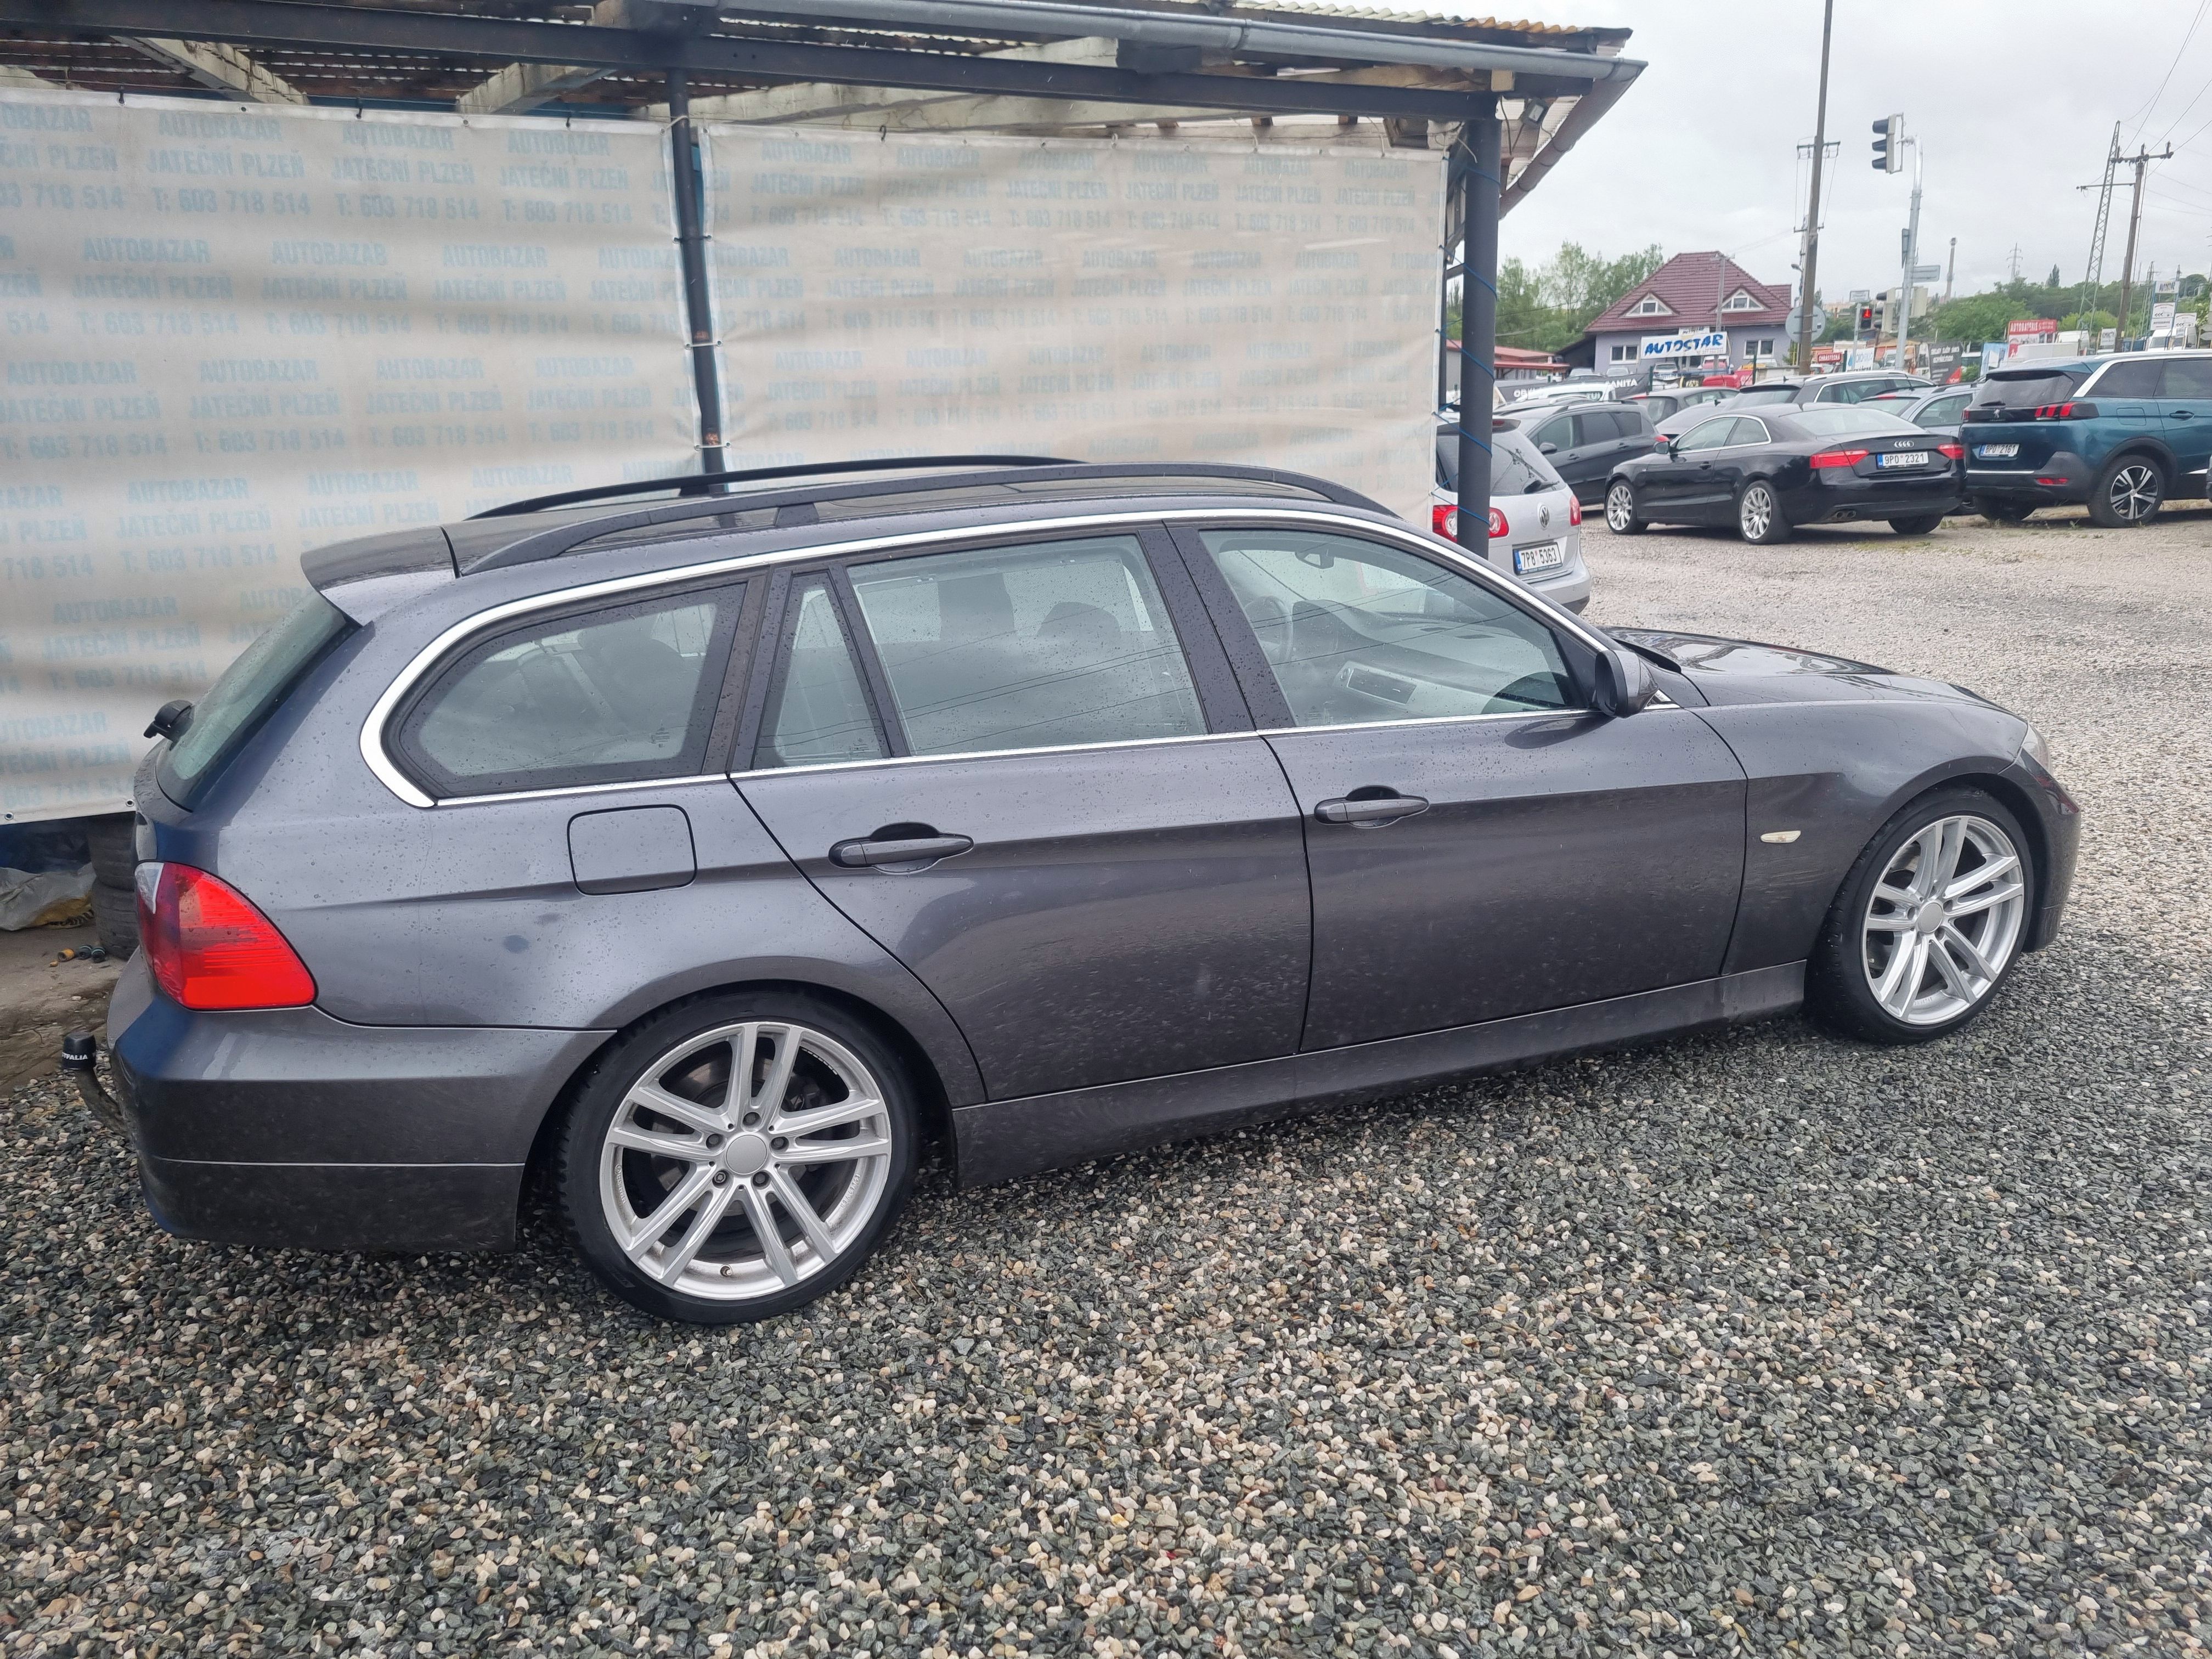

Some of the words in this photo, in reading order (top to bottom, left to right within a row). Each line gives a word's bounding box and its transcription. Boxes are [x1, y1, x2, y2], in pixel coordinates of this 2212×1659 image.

[158, 111, 283, 140] AUTOBAZAR
[342, 122, 455, 151] AUTOBAZAR
[507, 131, 611, 156] AUTOBAZAR
[761, 141, 852, 163] AUTOBAZAR
[31, 183, 75, 209] 718
[82, 185, 127, 210] 514
[178, 188, 218, 213] 603
[225, 189, 266, 215] 718
[274, 191, 313, 216] 514
[359, 193, 396, 219] 603
[403, 195, 439, 219] 718
[445, 195, 480, 220] 514
[524, 200, 557, 223] 603
[564, 201, 596, 224] 718
[602, 201, 633, 224] 514
[82, 237, 212, 263] AUTOBAZAR
[272, 240, 388, 266] AUTOBAZAR
[442, 244, 549, 268] AUTOBAZAR
[6, 311, 50, 335] 514
[104, 311, 145, 335] 603
[151, 311, 193, 335] 718
[199, 312, 240, 335] 514
[288, 312, 327, 335] 603
[332, 312, 368, 335] 718
[375, 312, 412, 335] 514
[457, 312, 490, 335] 603
[499, 312, 531, 335] 718
[537, 312, 569, 335] 514
[611, 313, 642, 335] 603
[1645, 334, 1723, 355] AUTOSTAR
[7, 360, 138, 385] AUTOBAZAR
[198, 358, 320, 383] AUTOBAZAR
[375, 356, 485, 380] AUTOBAZAR
[535, 356, 636, 379] AUTOBAZAR
[218, 428, 258, 453] 603
[265, 428, 302, 452] 718
[309, 427, 347, 450] 514
[391, 425, 426, 447] 603
[434, 425, 466, 447] 718
[473, 425, 509, 447] 514
[549, 421, 580, 443] 603
[589, 421, 618, 443] 718
[624, 420, 654, 441] 514
[27, 434, 70, 459] 603
[80, 434, 120, 458] 718
[127, 432, 168, 456] 514
[1905, 453, 1924, 463] 2321
[307, 471, 420, 495] AUTOBAZAR
[471, 464, 573, 489] AUTOBAZAR
[127, 477, 250, 504] AUTOBAZAR
[3, 555, 45, 581] 718
[53, 553, 95, 579] 514
[146, 548, 188, 572] 603
[193, 545, 234, 568] 718
[239, 543, 276, 567] 514
[1521, 550, 1536, 568] 7P8
[1539, 548, 1556, 564] 5363
[52, 596, 179, 624] AUTOBAZAR
[75, 667, 115, 689] 603
[121, 663, 162, 686] 718
[169, 659, 208, 684] 514
